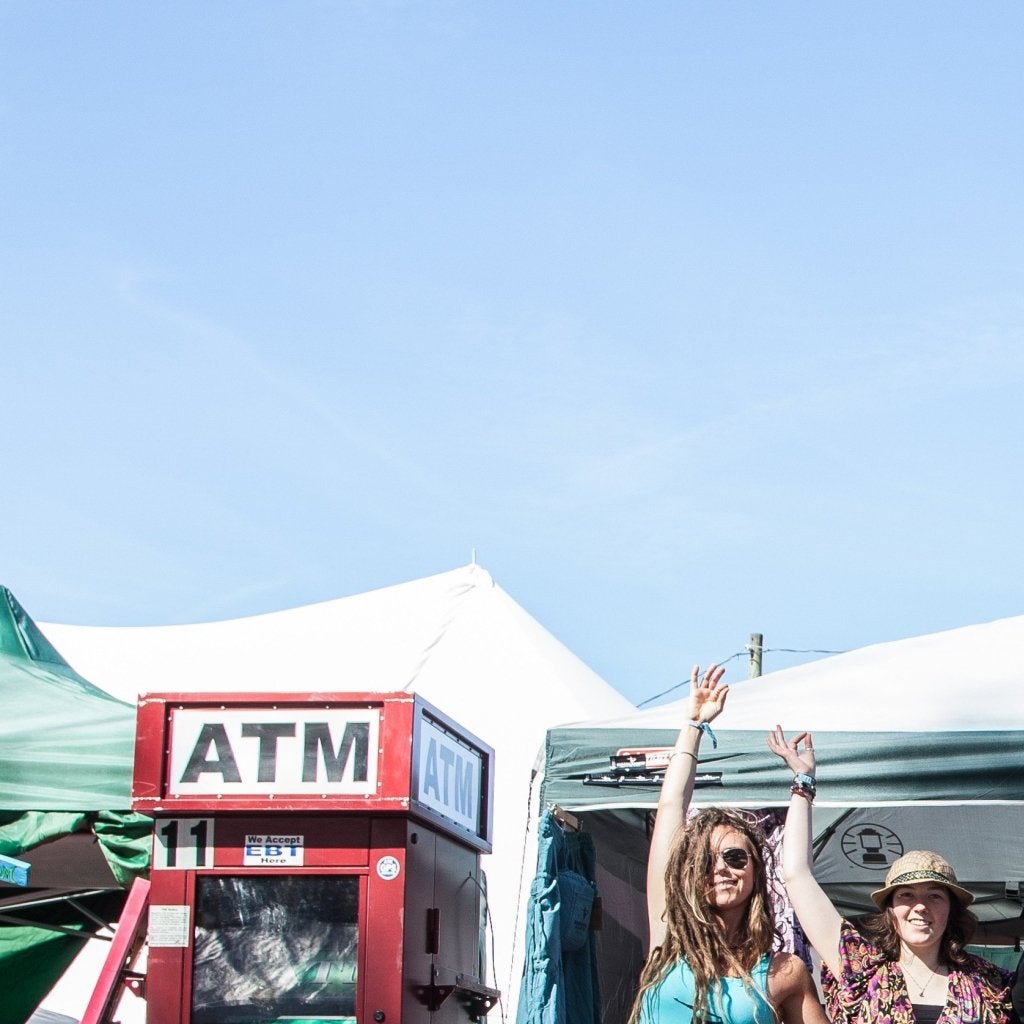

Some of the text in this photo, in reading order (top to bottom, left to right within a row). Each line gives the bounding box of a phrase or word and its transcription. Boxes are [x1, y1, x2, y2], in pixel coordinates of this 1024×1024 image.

[179, 722, 370, 784] ATM
[424, 737, 475, 820] ATM
[161, 820, 208, 867] 11
[246, 845, 304, 857] EBT
[266, 836, 300, 845] Accept
